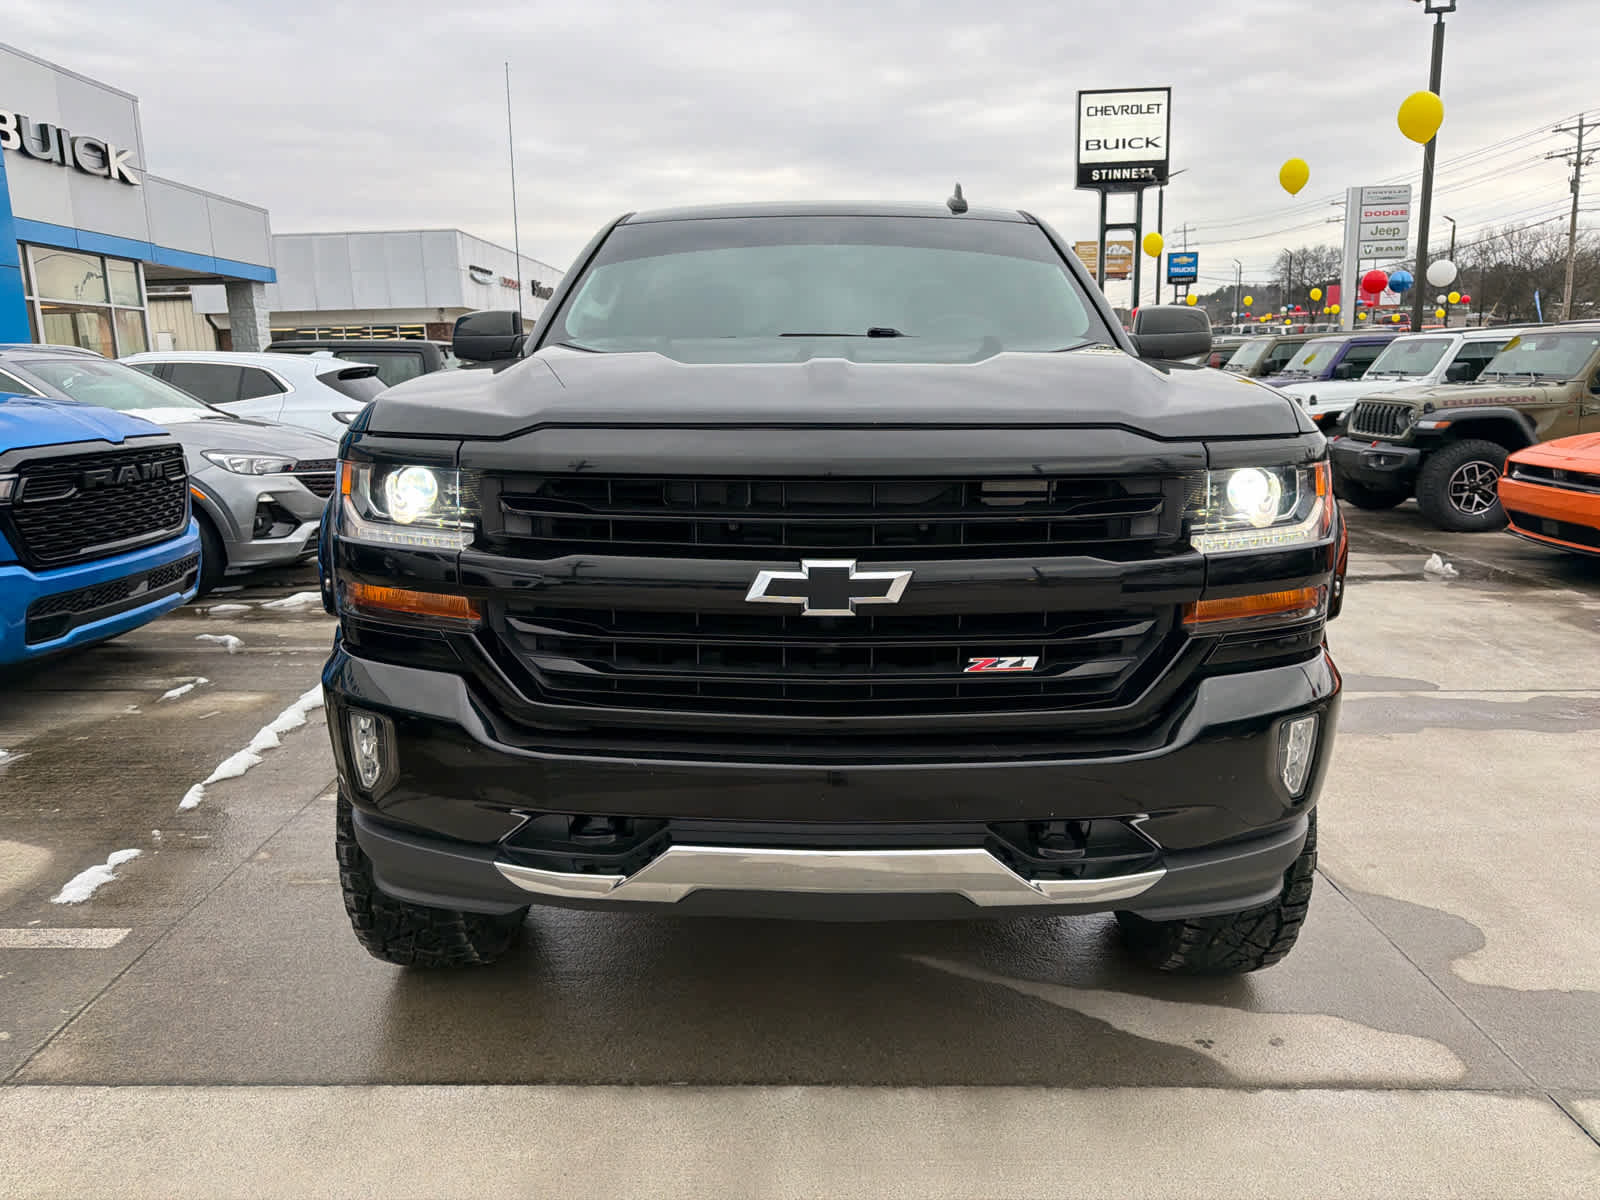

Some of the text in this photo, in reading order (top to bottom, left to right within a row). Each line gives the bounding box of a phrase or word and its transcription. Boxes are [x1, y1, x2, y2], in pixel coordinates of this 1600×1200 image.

[1086, 103, 1162, 117] CHEVROLET
[0, 109, 140, 185] BUICK
[1085, 136, 1161, 151] BUICK
[1364, 209, 1408, 217] DODGE
[1370, 225, 1400, 237] Jeep
[1442, 395, 1537, 406] RUBICON
[82, 462, 164, 488] RAM
[963, 656, 1040, 672] Z71
